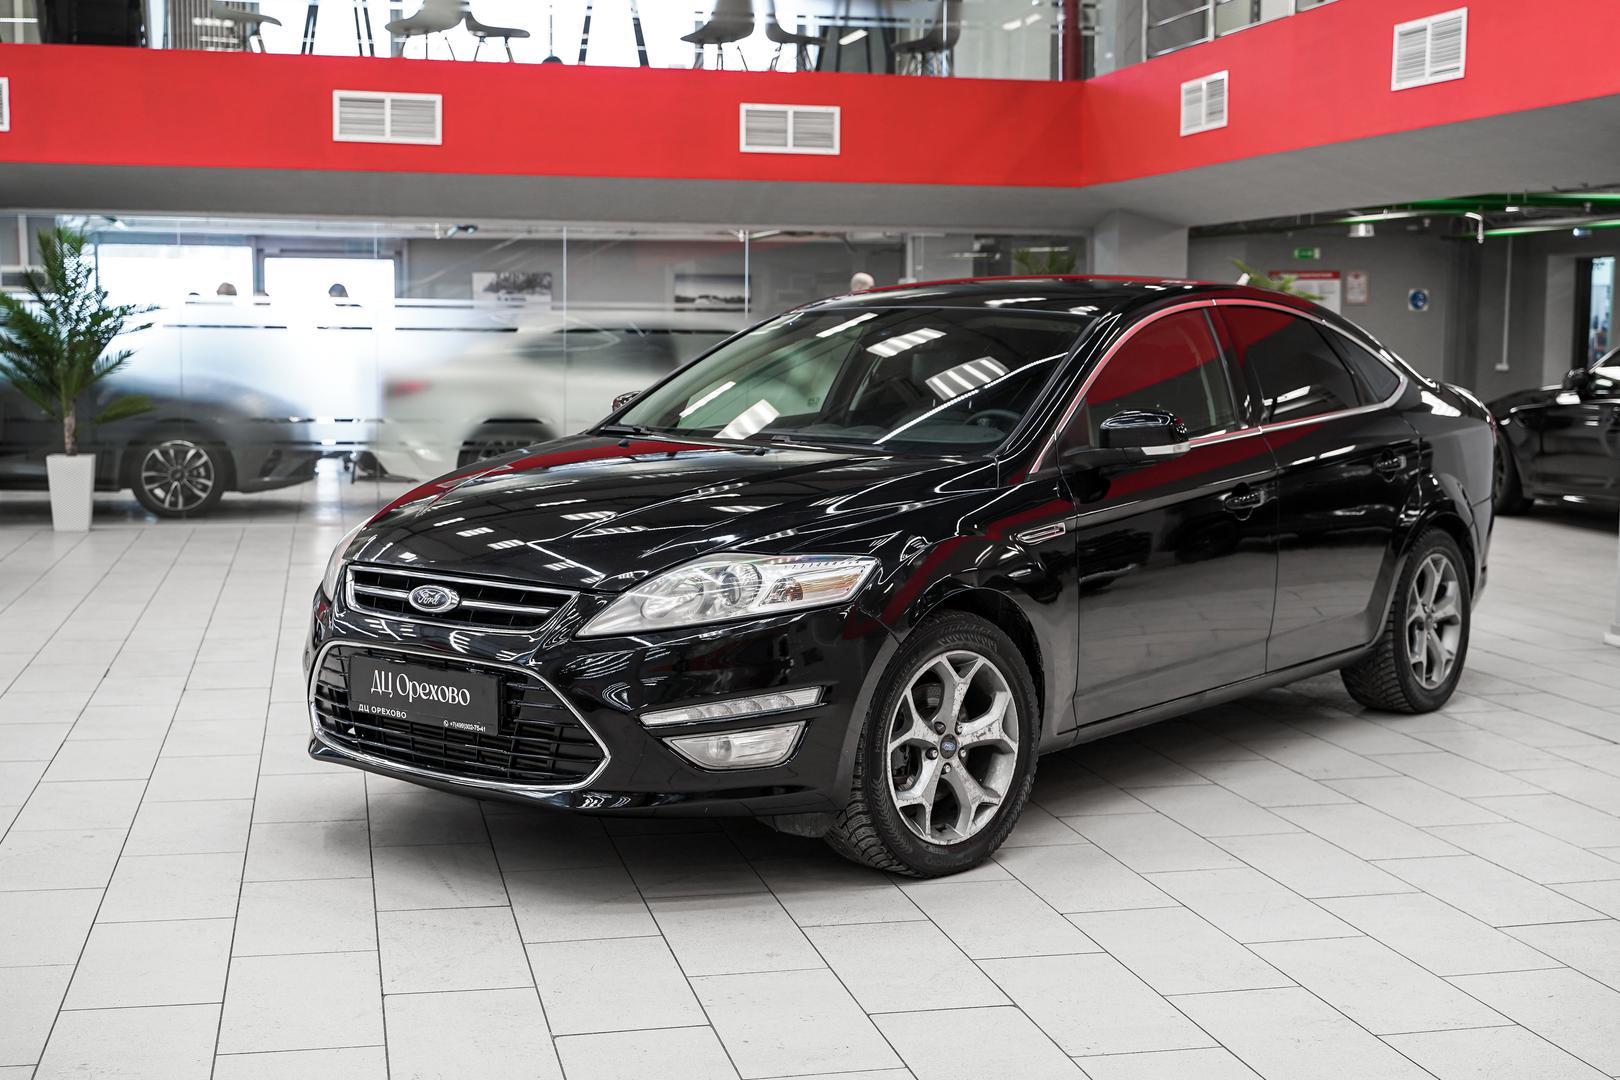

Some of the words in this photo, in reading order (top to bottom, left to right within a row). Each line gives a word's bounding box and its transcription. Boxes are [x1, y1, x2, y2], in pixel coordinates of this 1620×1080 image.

[414, 588, 445, 606] Ford
[370, 669, 394, 698] ДЦ
[396, 673, 471, 706] Орехово
[358, 703, 370, 714] ДЦ
[371, 706, 407, 719] ОРЕХОВО
